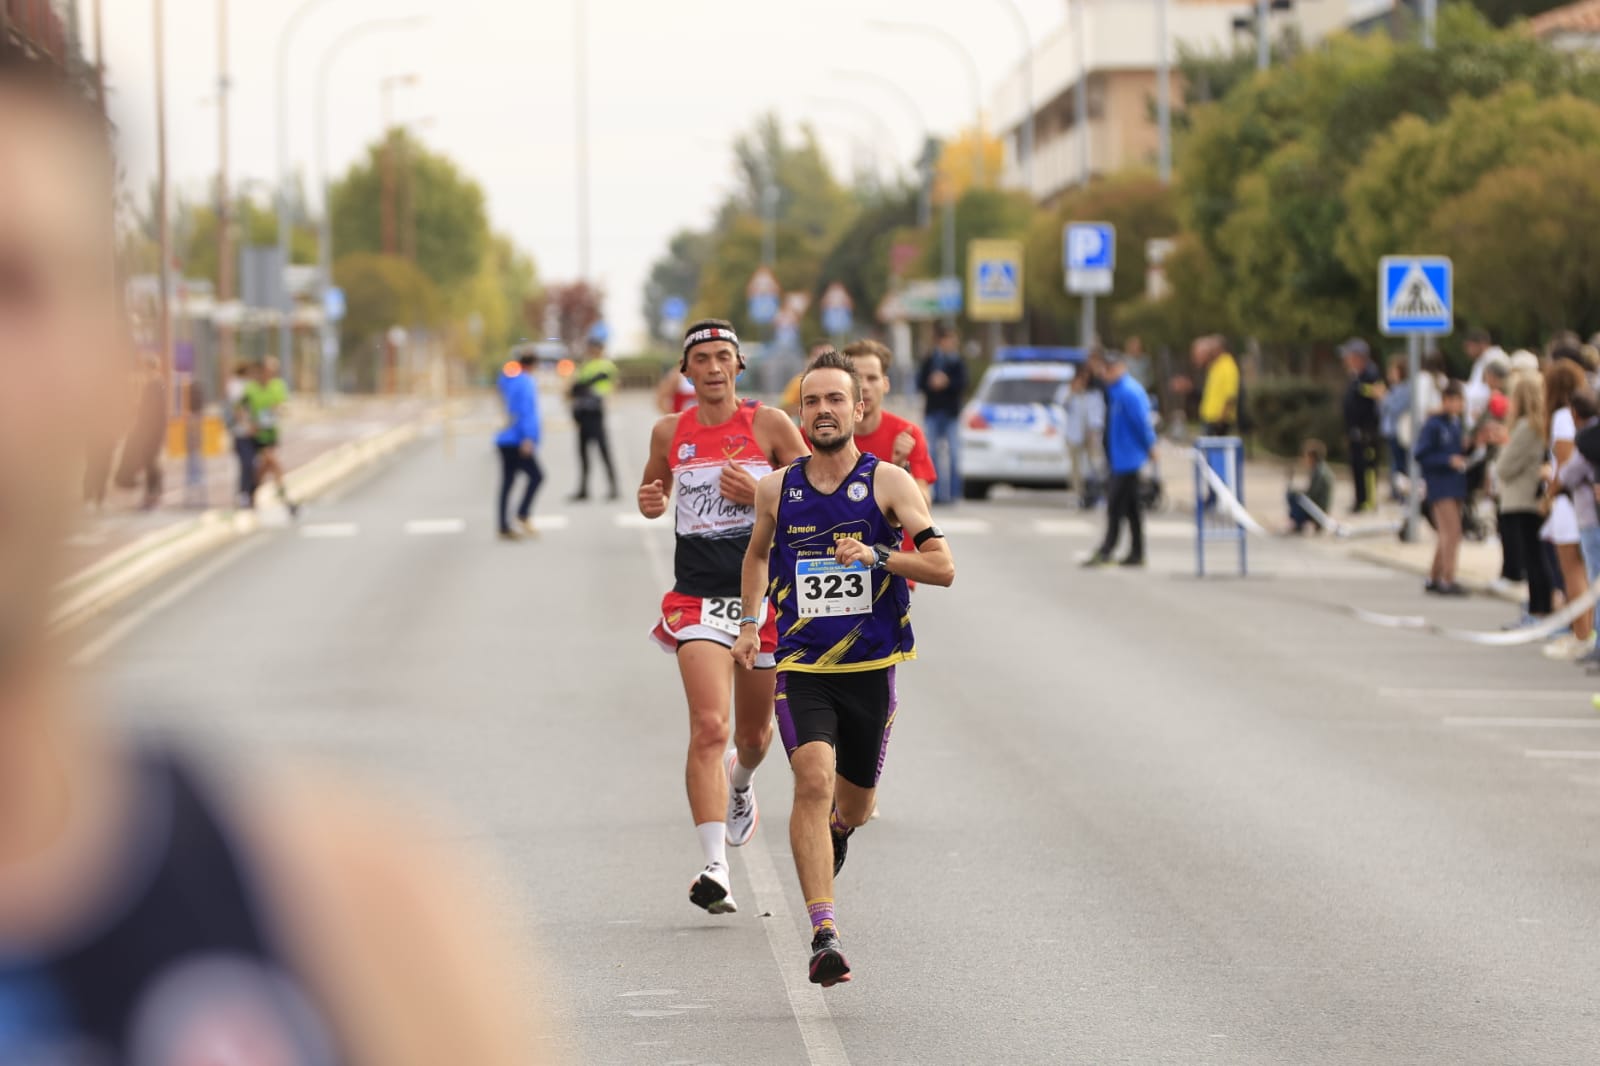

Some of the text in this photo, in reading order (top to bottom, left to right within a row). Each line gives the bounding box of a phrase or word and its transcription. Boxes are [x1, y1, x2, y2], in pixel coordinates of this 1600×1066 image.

[1073, 229, 1102, 266] P
[679, 471, 716, 497] Simón
[787, 524, 817, 534] Jamón
[804, 573, 864, 600] 323
[712, 599, 752, 627] 26
